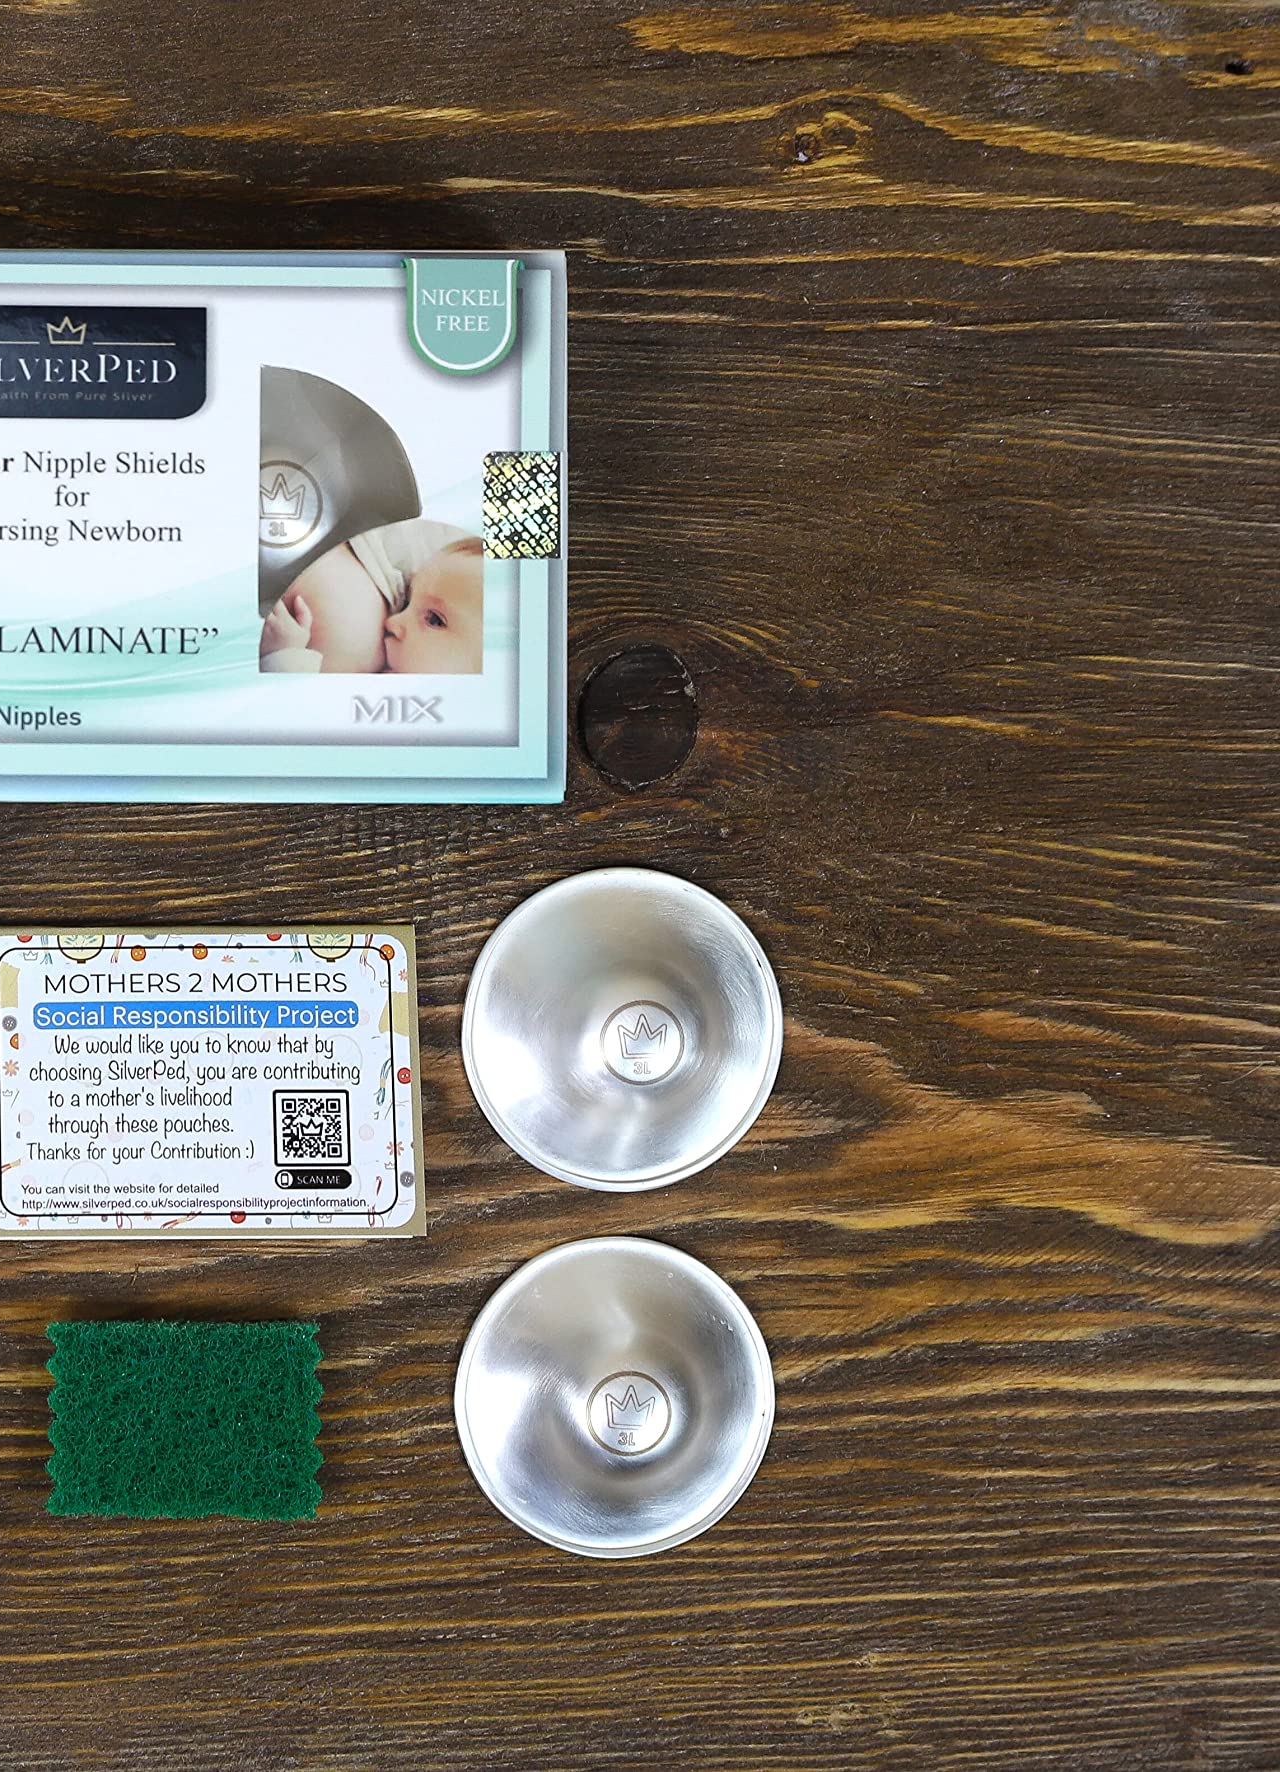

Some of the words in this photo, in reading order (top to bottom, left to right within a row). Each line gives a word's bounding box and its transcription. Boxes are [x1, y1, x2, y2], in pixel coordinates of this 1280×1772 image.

[421, 289, 505, 307] NICKEL
[436, 315, 490, 332] FREE
[35, 391, 69, 400] From
[75, 391, 106, 401] Pure
[113, 391, 153, 401] Silver
[23, 451, 106, 478] Nipple
[115, 452, 205, 474] Shields
[55, 485, 90, 507] for
[67, 519, 183, 542] Newborn
[352, 695, 443, 723] MIX
[45, 973, 180, 994] MOTHERS
[188, 973, 203, 993] 2
[212, 972, 347, 993] MOTHERS
[36, 1005, 105, 1027] Social
[113, 1004, 270, 1029] Responsibility
[277, 1005, 356, 1028] Project
[54, 1034, 80, 1054] We
[86, 1034, 132, 1054] would
[138, 1034, 164, 1054] like
[170, 1040, 199, 1059] you
[205, 1036, 221, 1053] to
[227, 1033, 271, 1055] know
[277, 1034, 309, 1054] that
[315, 1034, 334, 1059] by
[29, 1061, 102, 1086] choosing
[108, 1059, 191, 1084] SilverPed,
[196, 1066, 225, 1085] you
[232, 1066, 257, 1080] are
[263, 1059, 361, 1085] contributing
[633, 1061, 651, 1075] 3L
[48, 1090, 64, 1107] to
[70, 1093, 81, 1107] a
[86, 1086, 155, 1107] mother's
[160, 1086, 232, 1107] livelihood
[48, 1113, 109, 1139] through
[115, 1113, 158, 1133] these
[164, 1112, 234, 1139] pouches.
[27, 1142, 81, 1161] Thanks
[87, 1141, 107, 1160] for
[112, 1147, 145, 1165] your
[151, 1140, 241, 1160] Contribution
[21, 1184, 42, 1194] You
[45, 1186, 65, 1194] can
[68, 1184, 91, 1194] visit
[93, 1184, 111, 1194] the
[113, 1184, 156, 1194] website
[159, 1183, 173, 1193] for
[176, 1183, 219, 1193] detailed
[297, 1175, 324, 1185] SCAN
[326, 1175, 341, 1185] ME
[617, 1431, 636, 1446] 3L
